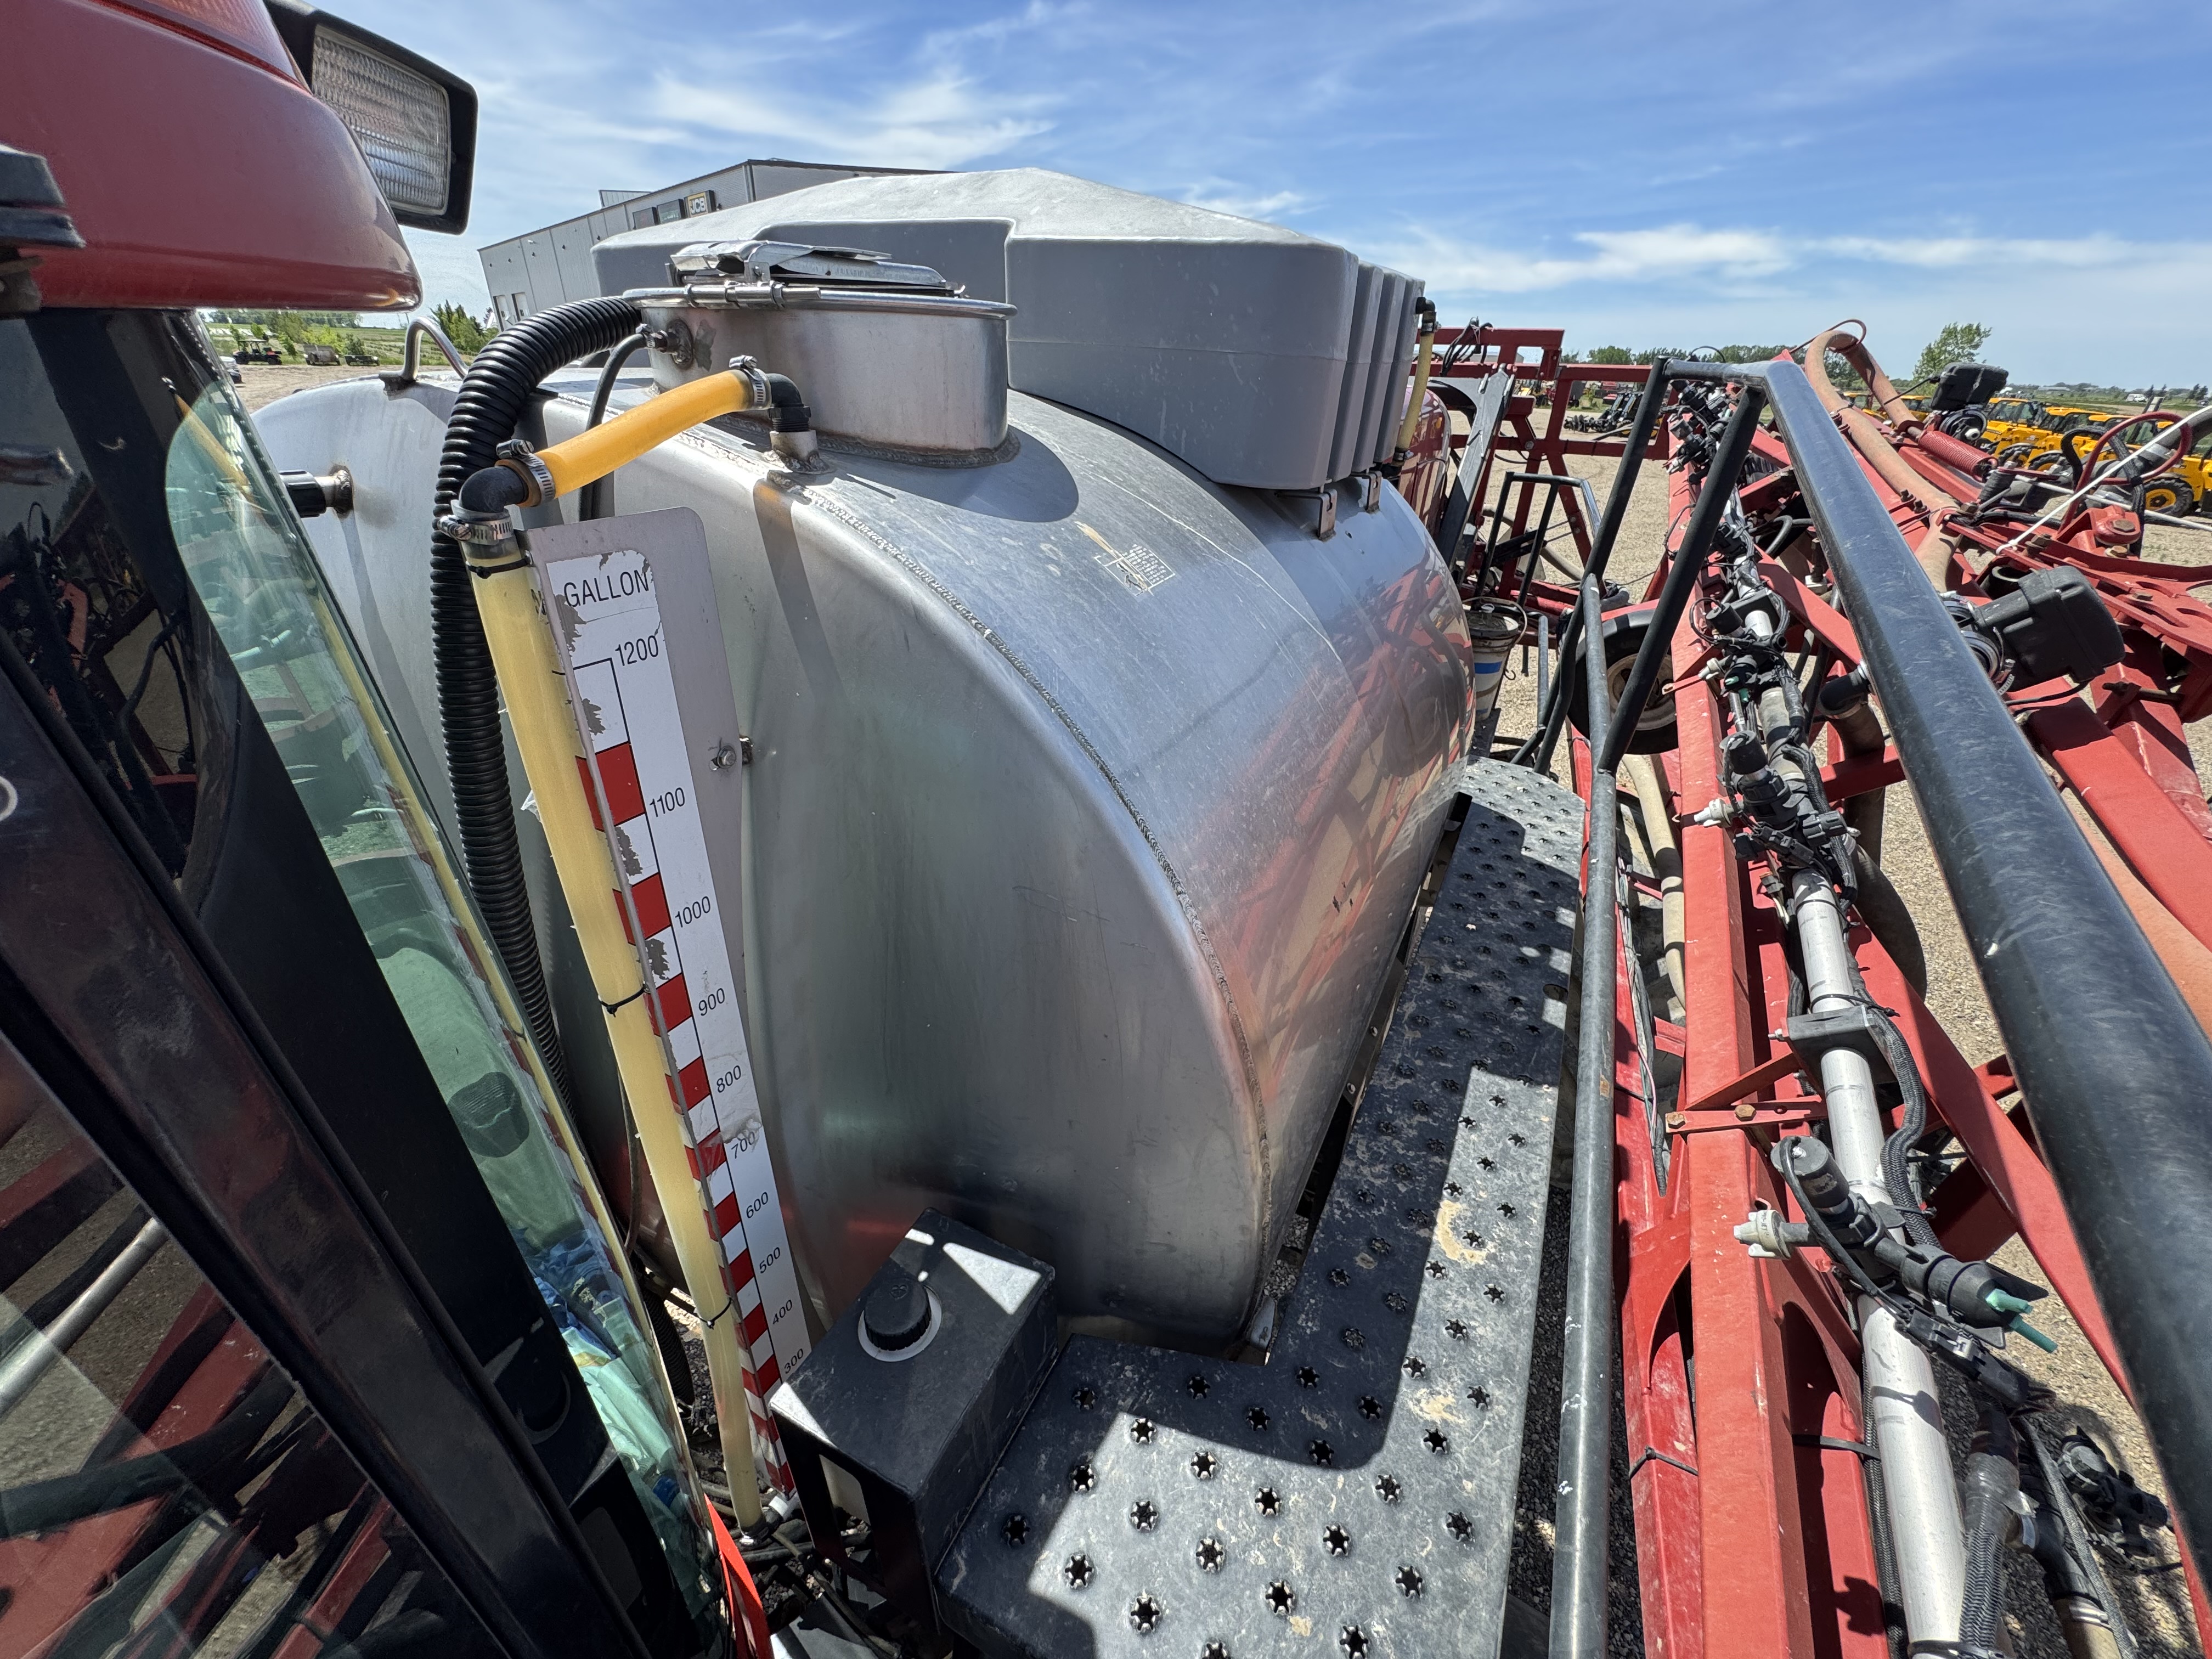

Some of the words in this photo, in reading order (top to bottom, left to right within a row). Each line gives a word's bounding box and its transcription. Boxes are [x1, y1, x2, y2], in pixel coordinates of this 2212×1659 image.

[691, 197, 706, 214] JCB
[564, 569, 650, 607] GALLON
[615, 635, 659, 666] 1200
[650, 787, 686, 817] 1100
[675, 896, 711, 928] 1000
[698, 988, 725, 1016] 900
[716, 1065, 742, 1093] 800
[731, 1131, 755, 1159] 700
[746, 1192, 769, 1219] 600
[759, 1247, 781, 1274] 500
[772, 1300, 793, 1325] 400
[784, 1348, 804, 1375] 300
